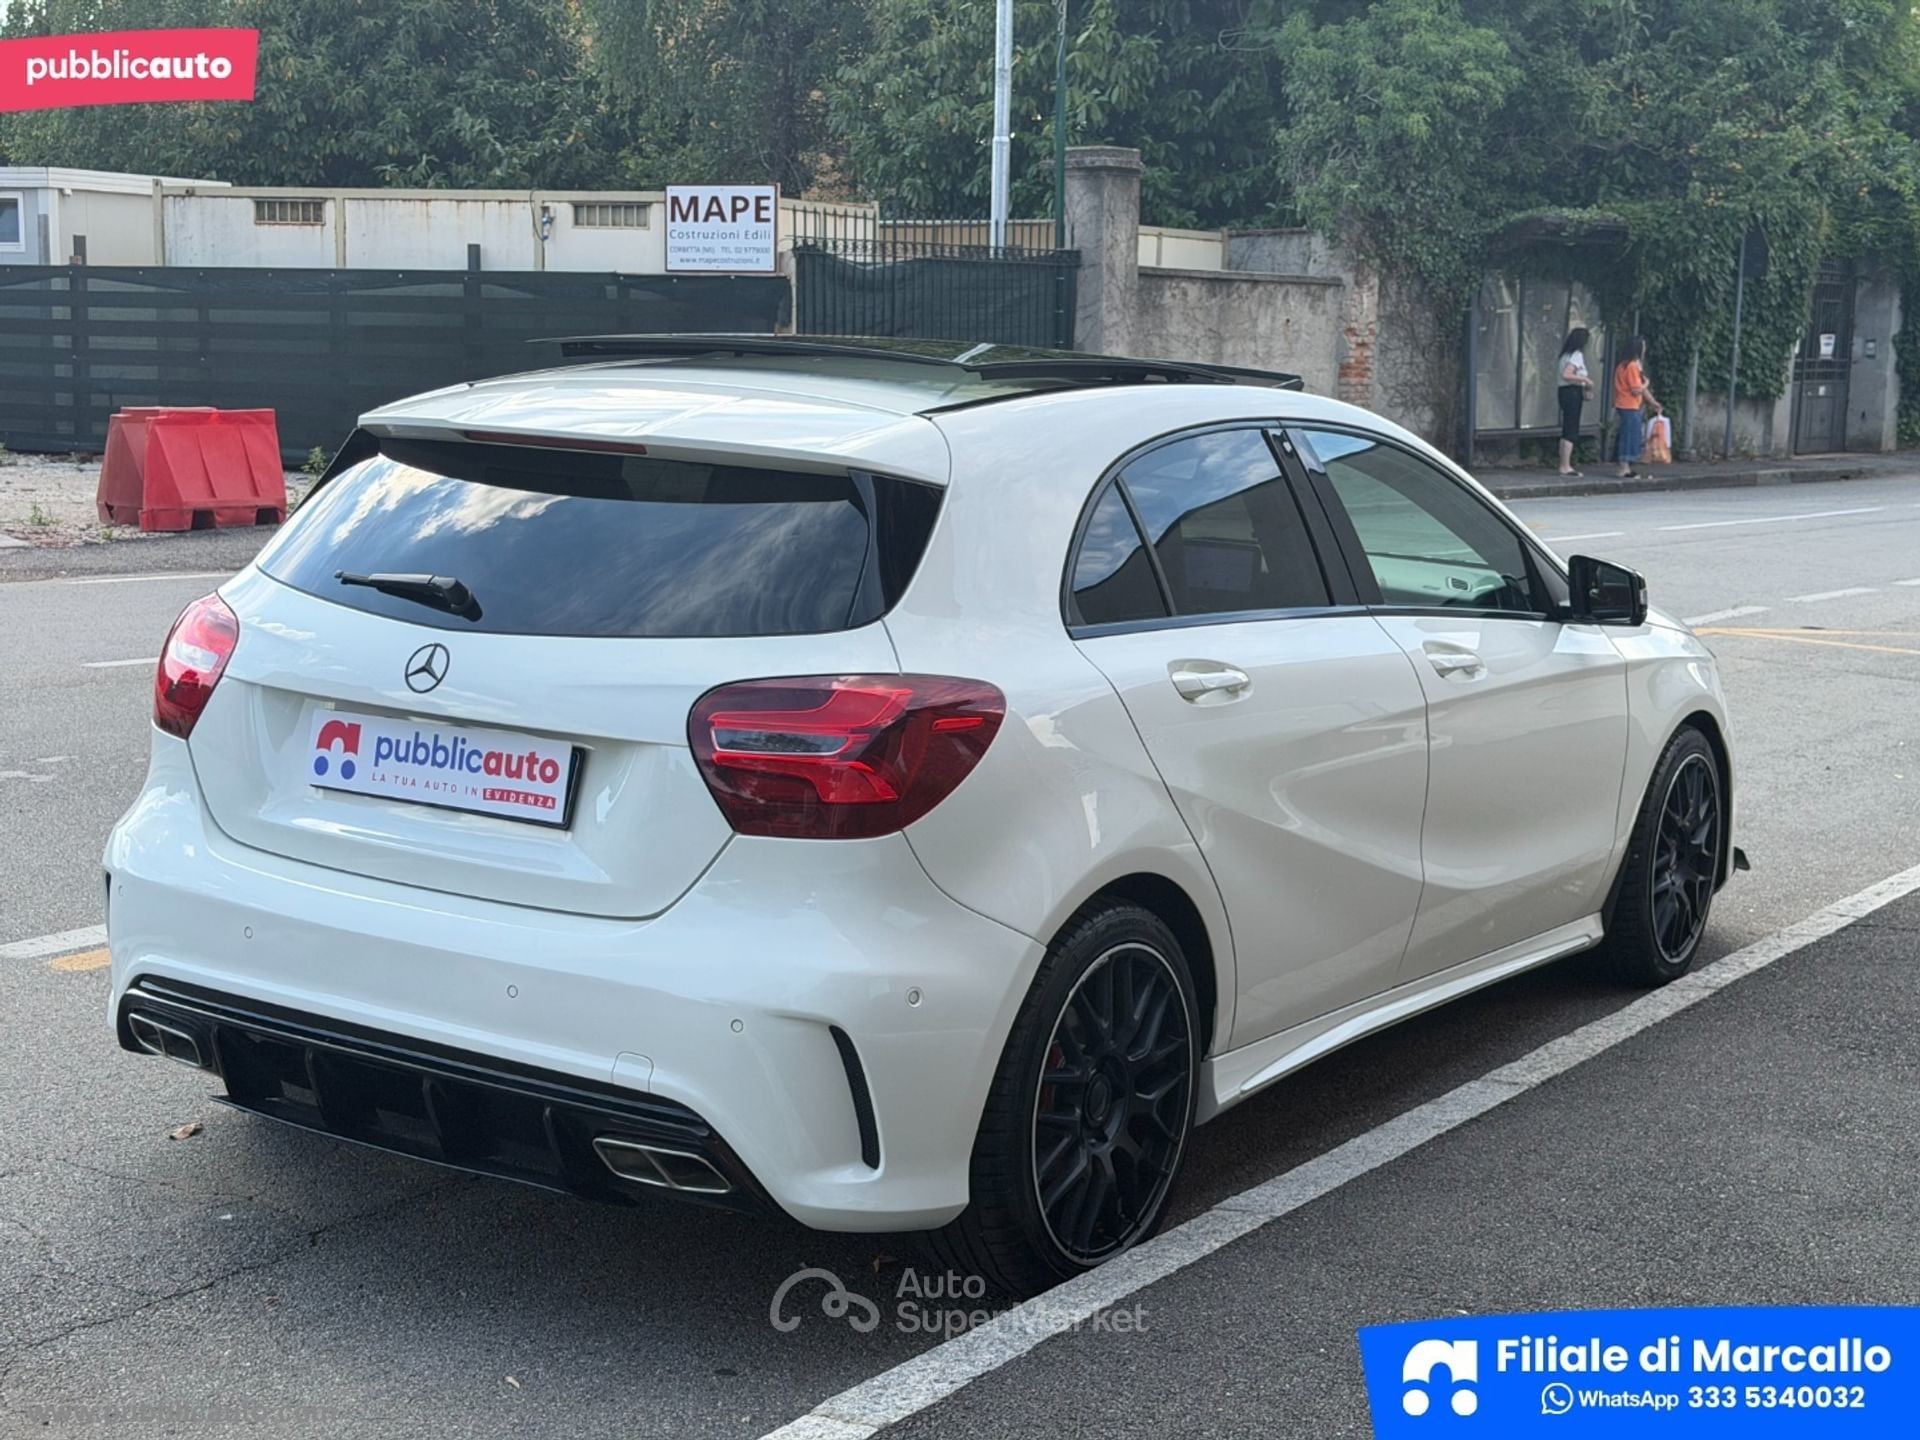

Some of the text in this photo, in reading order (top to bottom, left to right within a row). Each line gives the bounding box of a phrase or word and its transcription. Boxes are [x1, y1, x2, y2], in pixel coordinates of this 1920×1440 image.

[670, 195, 771, 223] MAPE
[669, 229, 771, 240] Costruzioni Edili
[373, 731, 560, 784] pubblicauto
[371, 772, 555, 808] LA TUA AUTO IN EVIDENZA
